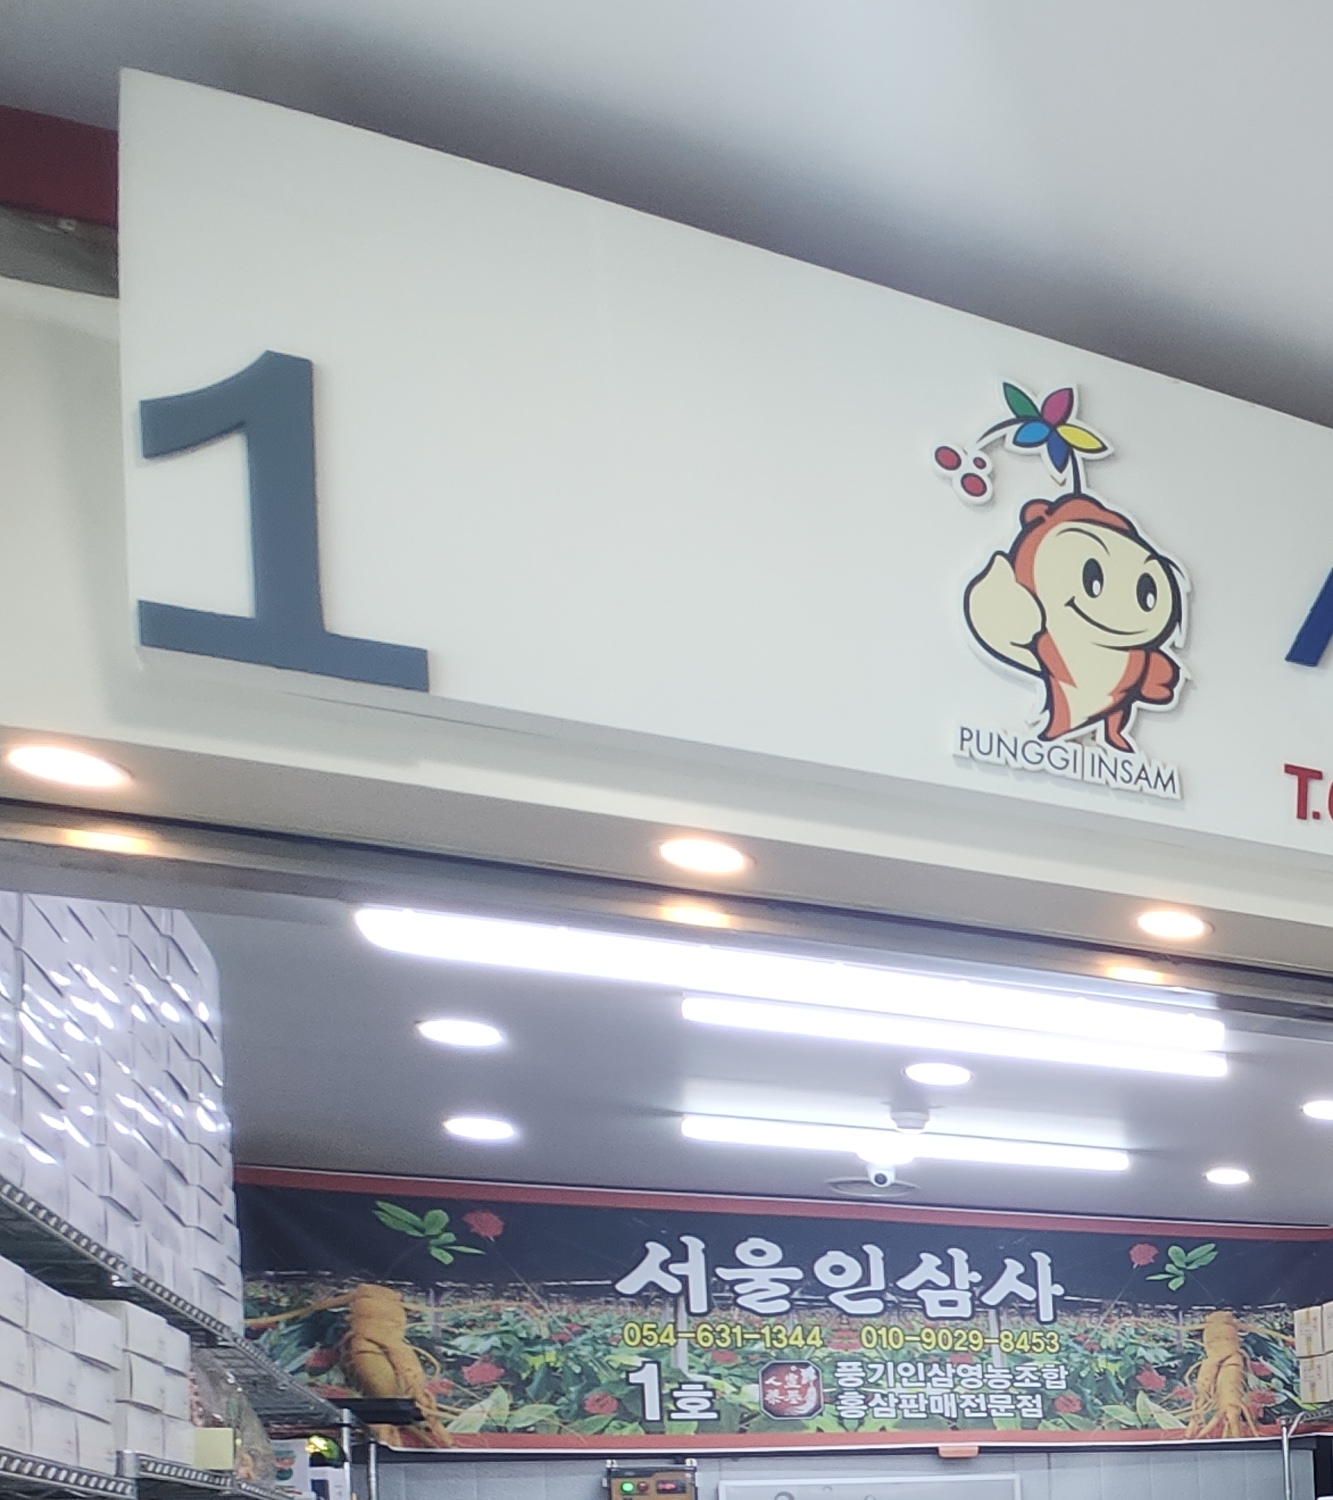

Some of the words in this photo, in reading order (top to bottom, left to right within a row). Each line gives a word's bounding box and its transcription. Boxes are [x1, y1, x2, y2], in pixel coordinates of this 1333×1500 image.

[138, 350, 430, 692] 1
[960, 727, 1077, 774] PUNGGI
[1091, 753, 1176, 794] INSAM
[615, 1234, 1066, 1324] 서울인삼사
[623, 1322, 824, 1350] 054-631-1344
[860, 1325, 1061, 1355] 010-9029-8453
[627, 1362, 719, 1422] 1호
[834, 1361, 1069, 1390] 풍기인삼영농조합
[835, 1391, 1045, 1420] 홍삼판매전문점
